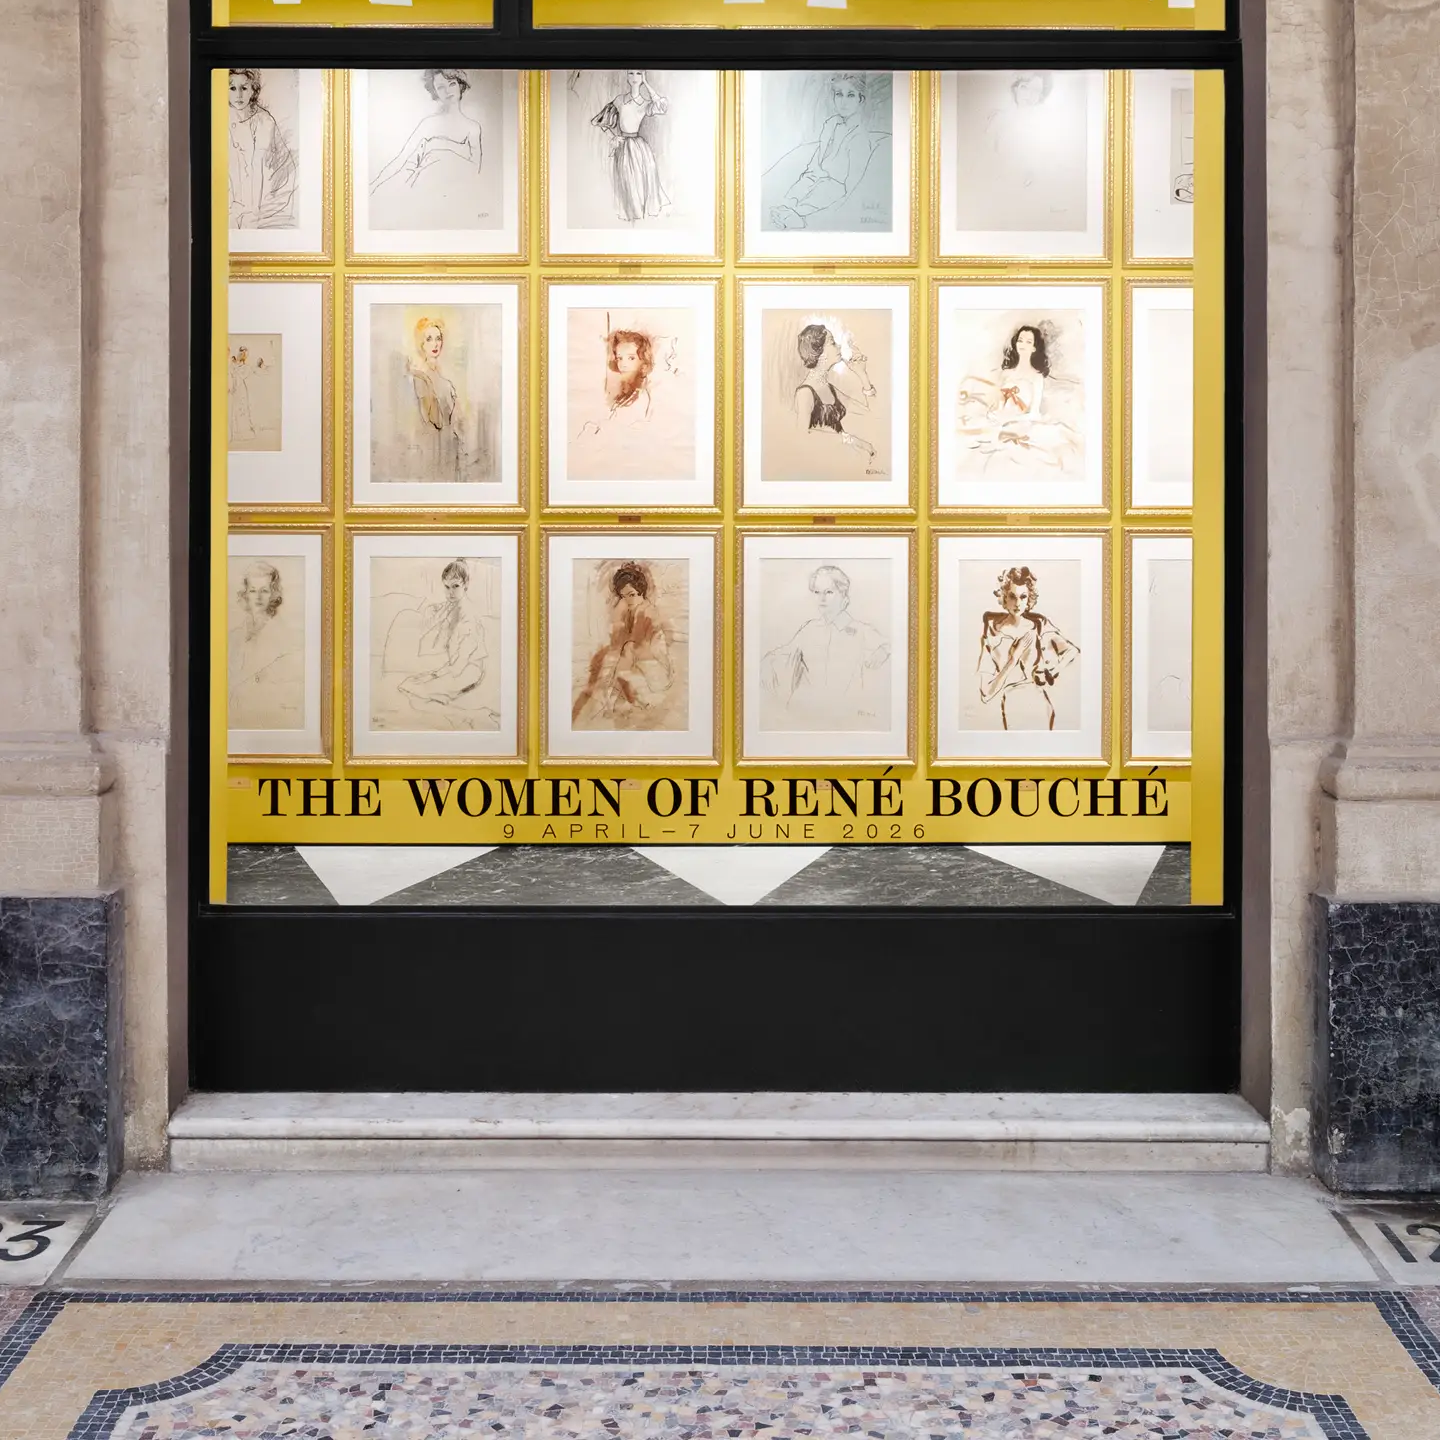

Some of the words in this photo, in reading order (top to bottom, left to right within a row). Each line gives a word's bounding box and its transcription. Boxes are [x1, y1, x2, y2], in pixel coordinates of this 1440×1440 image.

[258, 777, 381, 818] THE
[402, 777, 627, 818] WOMEN
[646, 777, 718, 818] OF
[738, 765, 903, 818] RENÉ
[925, 765, 1169, 818] BOUCHÉ
[503, 823, 515, 839] 9
[726, 823, 816, 840] JUNE
[842, 823, 925, 840] 2026
